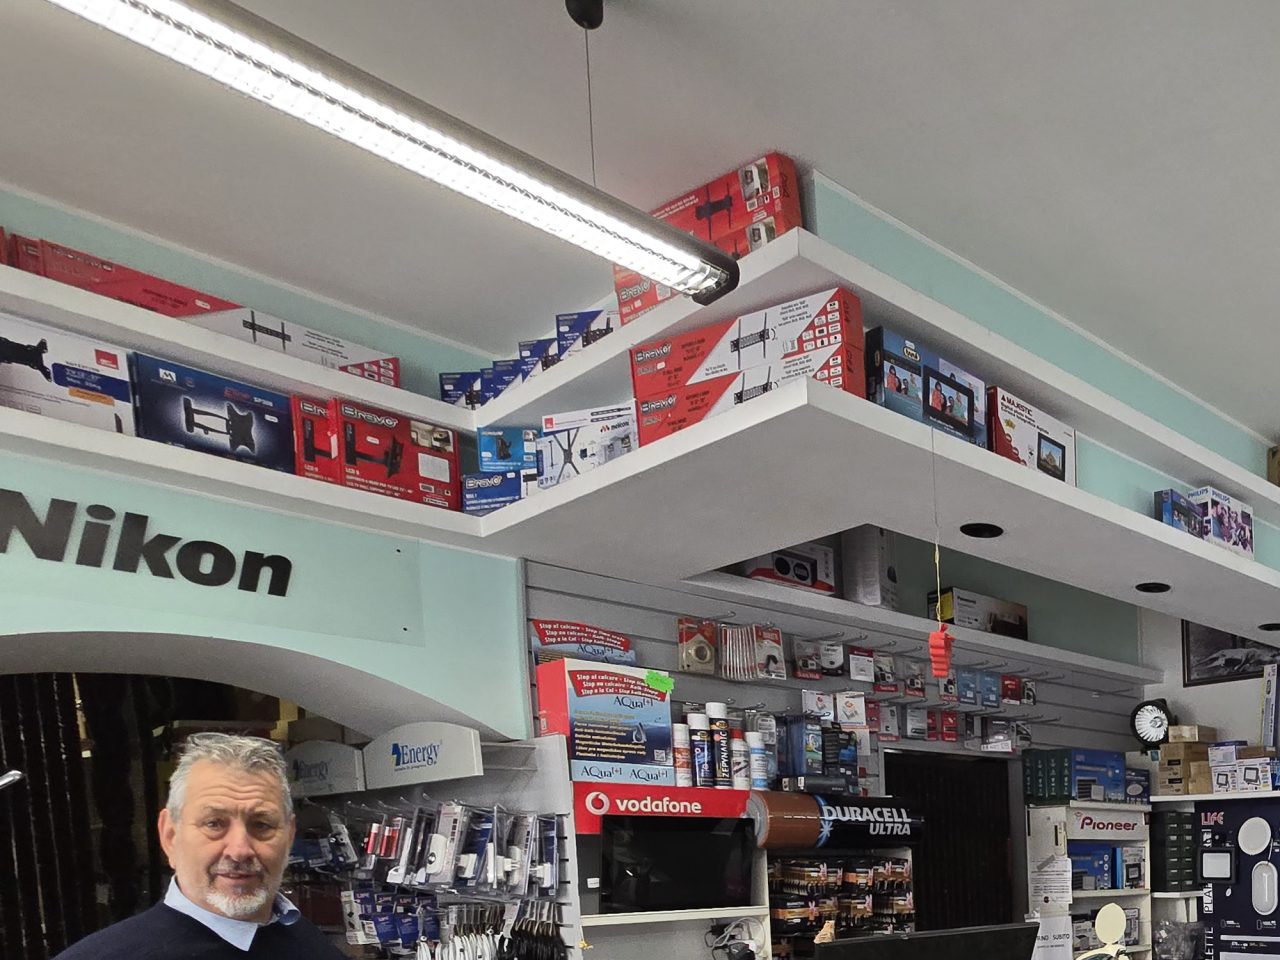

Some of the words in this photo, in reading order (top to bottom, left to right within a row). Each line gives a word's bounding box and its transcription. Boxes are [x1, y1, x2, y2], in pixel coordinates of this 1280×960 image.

[634, 342, 673, 363] Bravo
[640, 393, 677, 414] Bravo
[1006, 396, 1033, 416] MAJESTIC
[342, 405, 398, 428] Bravo
[465, 475, 503, 490] Bravo
[1187, 488, 1209, 499] PHILIPS
[1211, 490, 1231, 504] PHILIPS
[0, 488, 293, 597] Nikon
[615, 797, 702, 814] vodafone
[822, 805, 912, 823] DURACELL
[1080, 816, 1138, 831] Pioneer
[1201, 811, 1225, 826] LIFE
[869, 823, 911, 836] ULTRA
